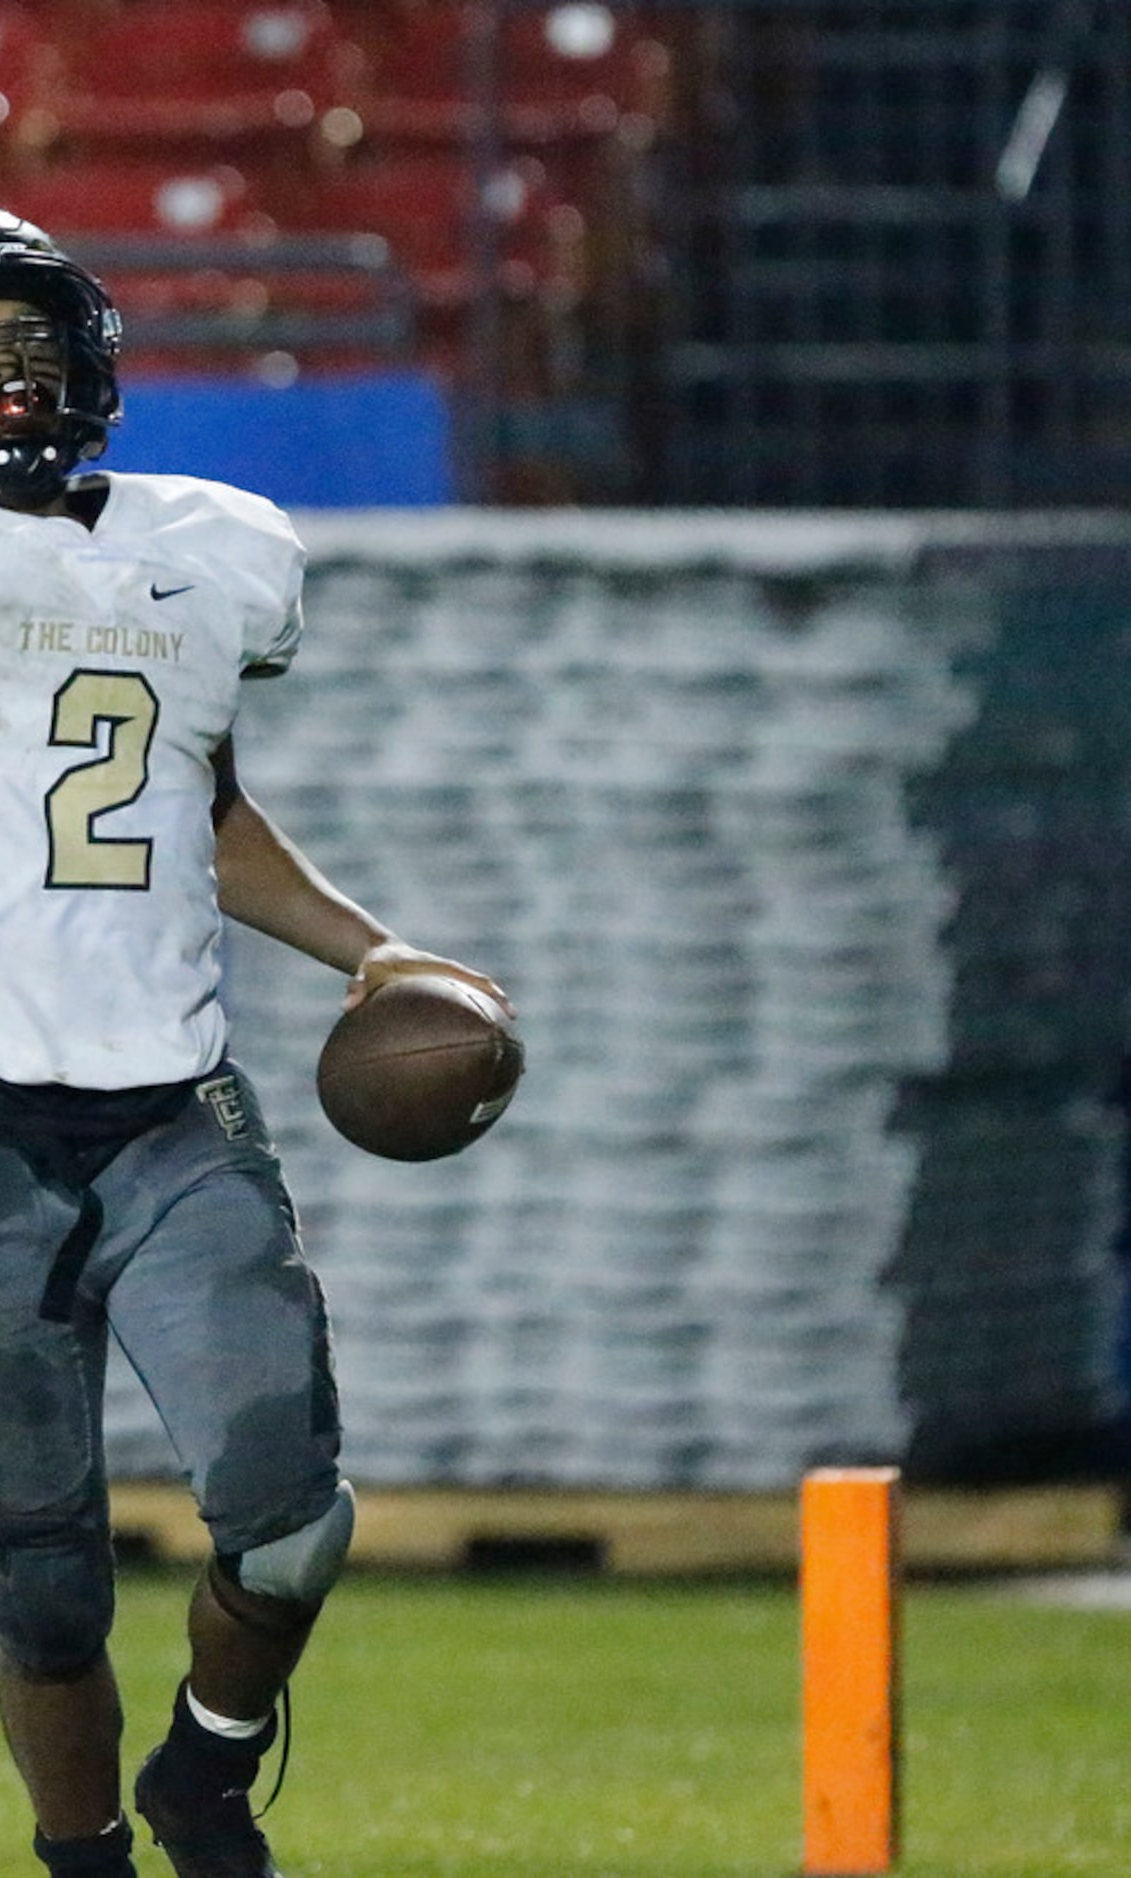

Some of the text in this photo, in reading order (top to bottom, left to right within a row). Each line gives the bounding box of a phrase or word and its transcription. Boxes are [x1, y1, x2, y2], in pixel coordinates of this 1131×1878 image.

[20, 621, 185, 662] THE COLONY
[43, 667, 161, 891] 2
